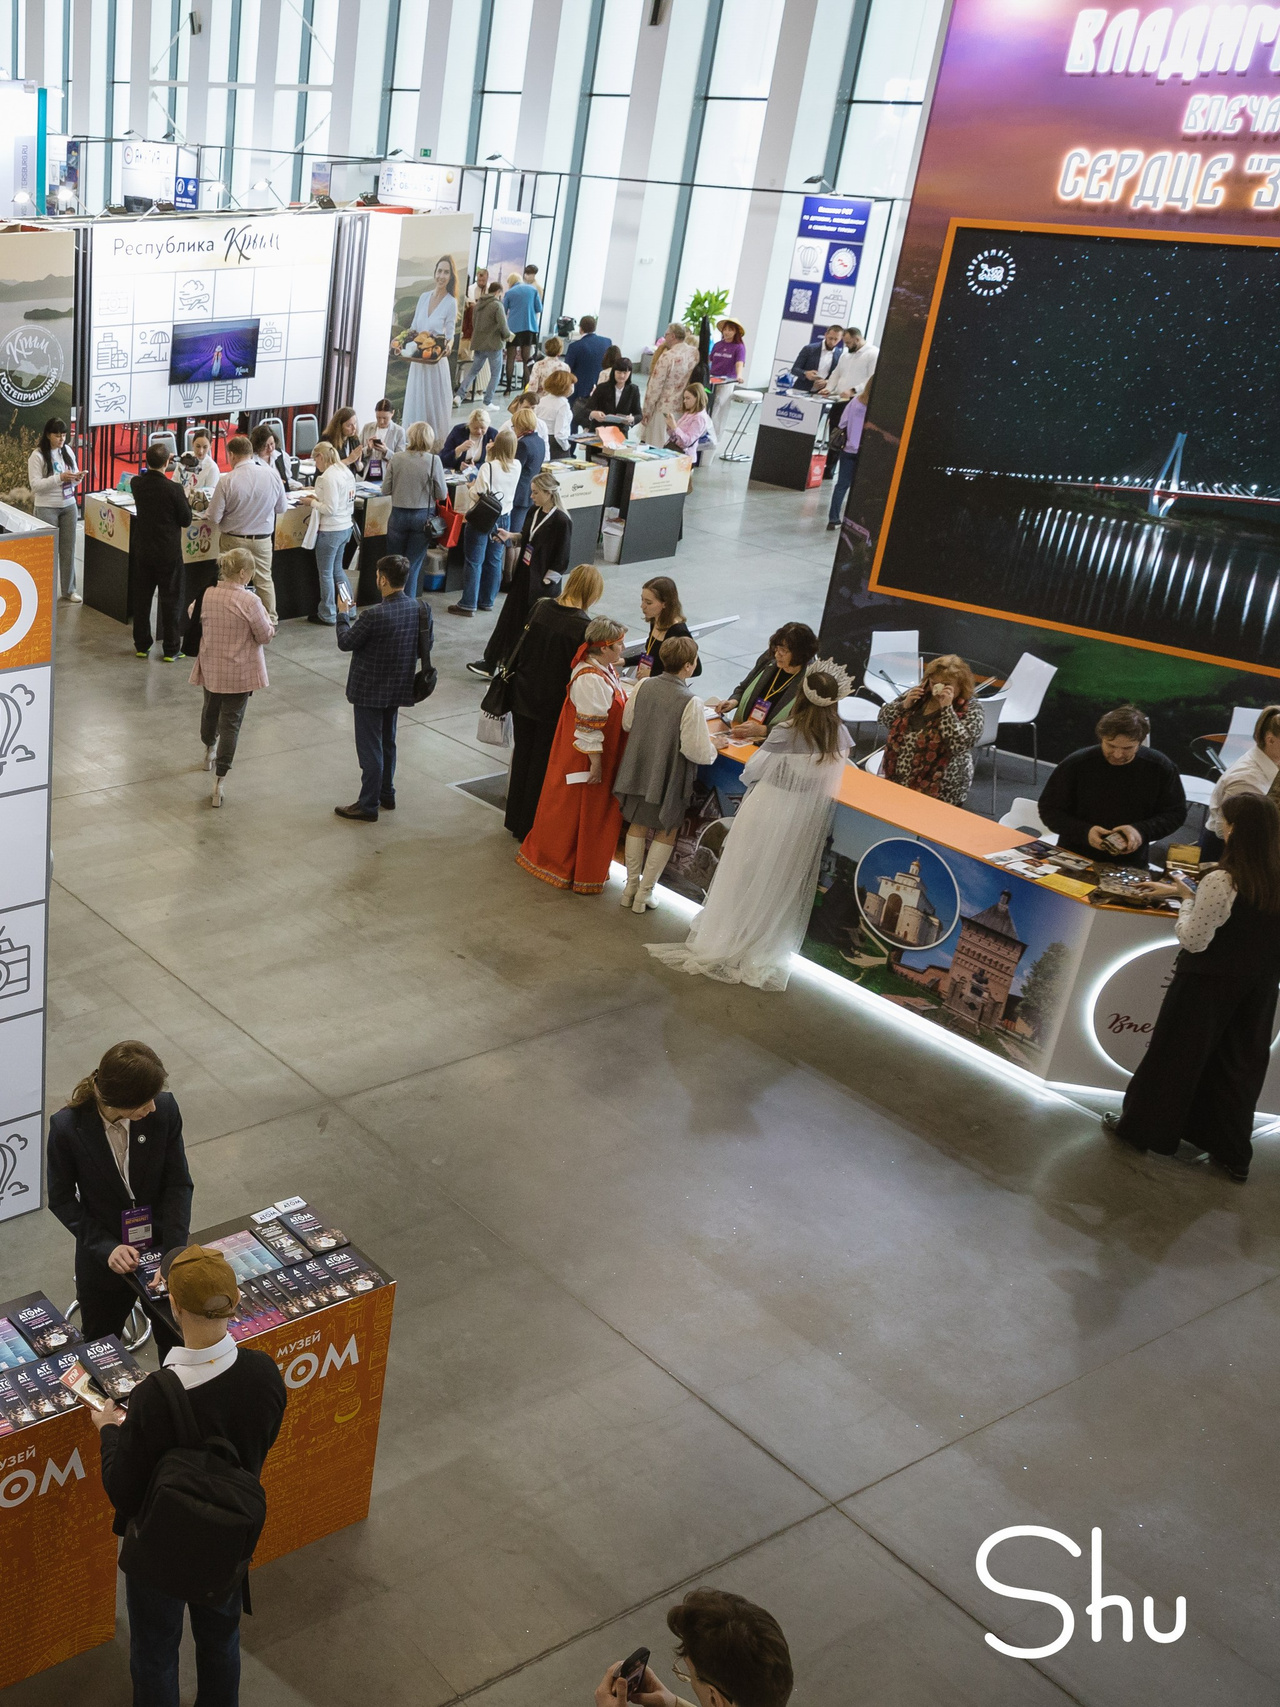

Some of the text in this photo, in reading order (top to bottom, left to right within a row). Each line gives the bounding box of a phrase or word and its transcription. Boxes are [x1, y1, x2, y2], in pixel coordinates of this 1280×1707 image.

[1058, 150, 1231, 211] СЕРДЦЕ
[113, 224, 280, 264] Республика Крым
[6, 332, 49, 364] Крым
[0, 367, 58, 401] ГОСТЕПРИИМНЫЙ
[789, 411, 803, 420] TOUR
[282, 1199, 302, 1209] АТОМ
[259, 1211, 278, 1221] АТОМ
[290, 1213, 313, 1223] АТОМ
[325, 1253, 350, 1266] АТОМ
[18, 1307, 46, 1321] АТОМ
[87, 1343, 113, 1357] АТОМ
[277, 1330, 321, 1357] МУЗЕЙ
[277, 1333, 359, 1389] ОМ
[36, 1364, 50, 1373] АТО
